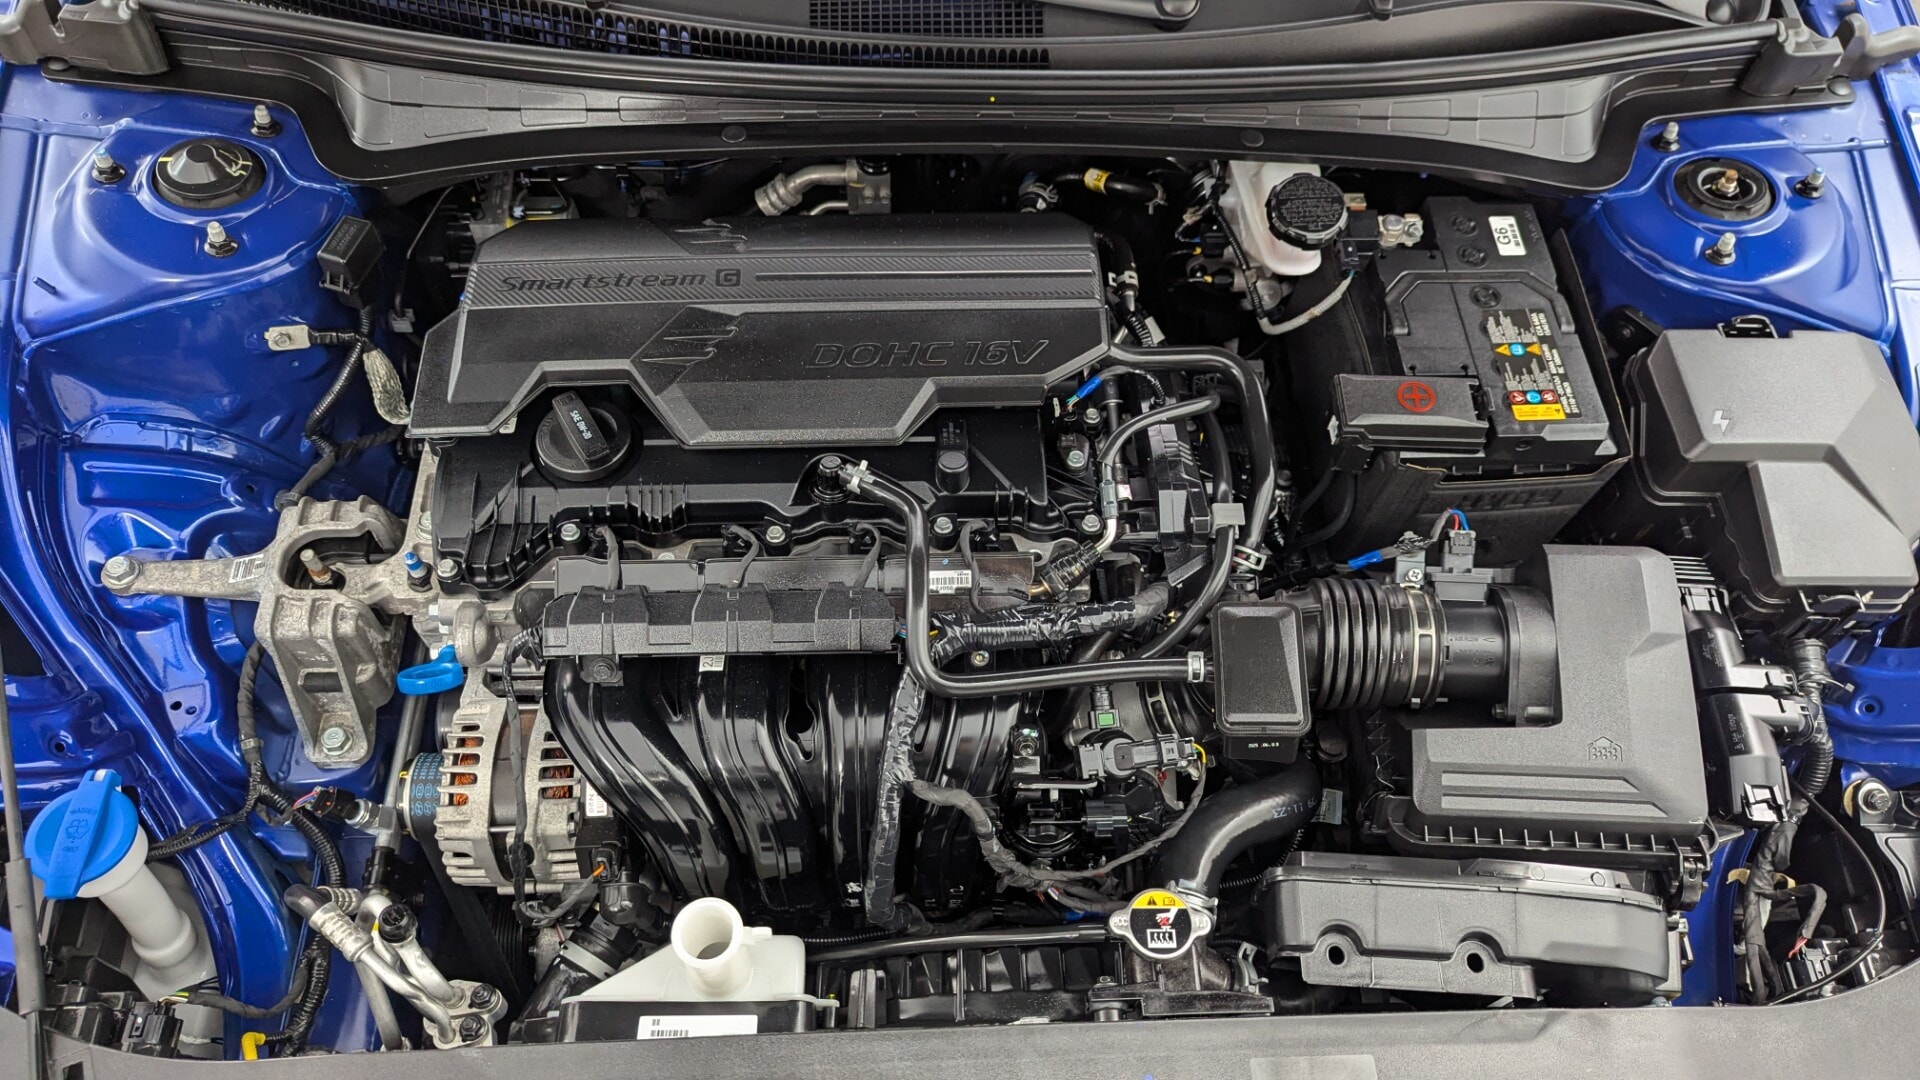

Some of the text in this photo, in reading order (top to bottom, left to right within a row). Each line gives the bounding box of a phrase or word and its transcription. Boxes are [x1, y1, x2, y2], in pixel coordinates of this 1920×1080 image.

[1494, 227, 1512, 245] G6
[499, 272, 706, 292] Smartstream
[805, 340, 1049, 368] DOHC 16V
[569, 409, 593, 440] SAE 0W-20
